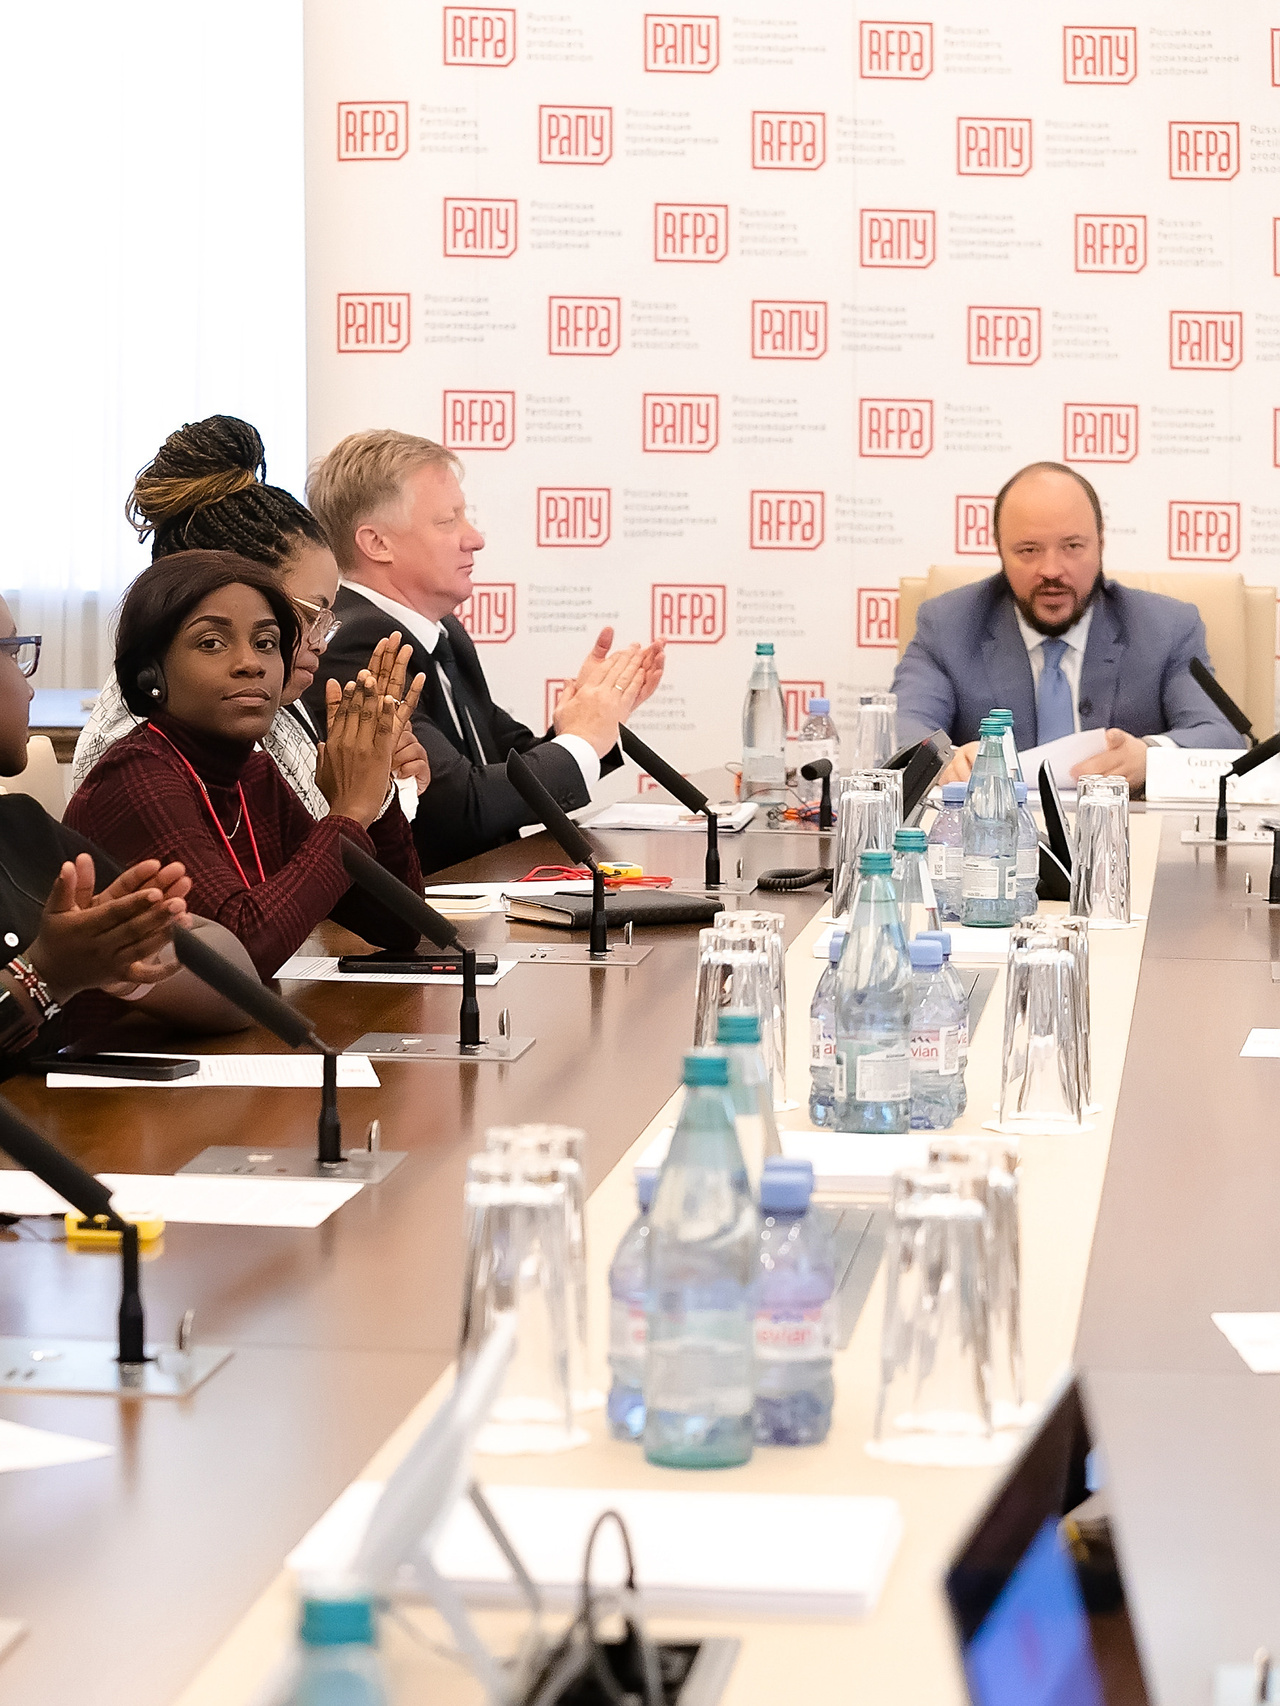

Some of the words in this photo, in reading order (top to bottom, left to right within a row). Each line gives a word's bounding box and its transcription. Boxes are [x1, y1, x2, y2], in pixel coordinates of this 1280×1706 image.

[1250, 125, 1280, 136] Russ
[1250, 138, 1280, 148] fertil
[1250, 152, 1280, 162] produ
[910, 1046, 939, 1058] vian
